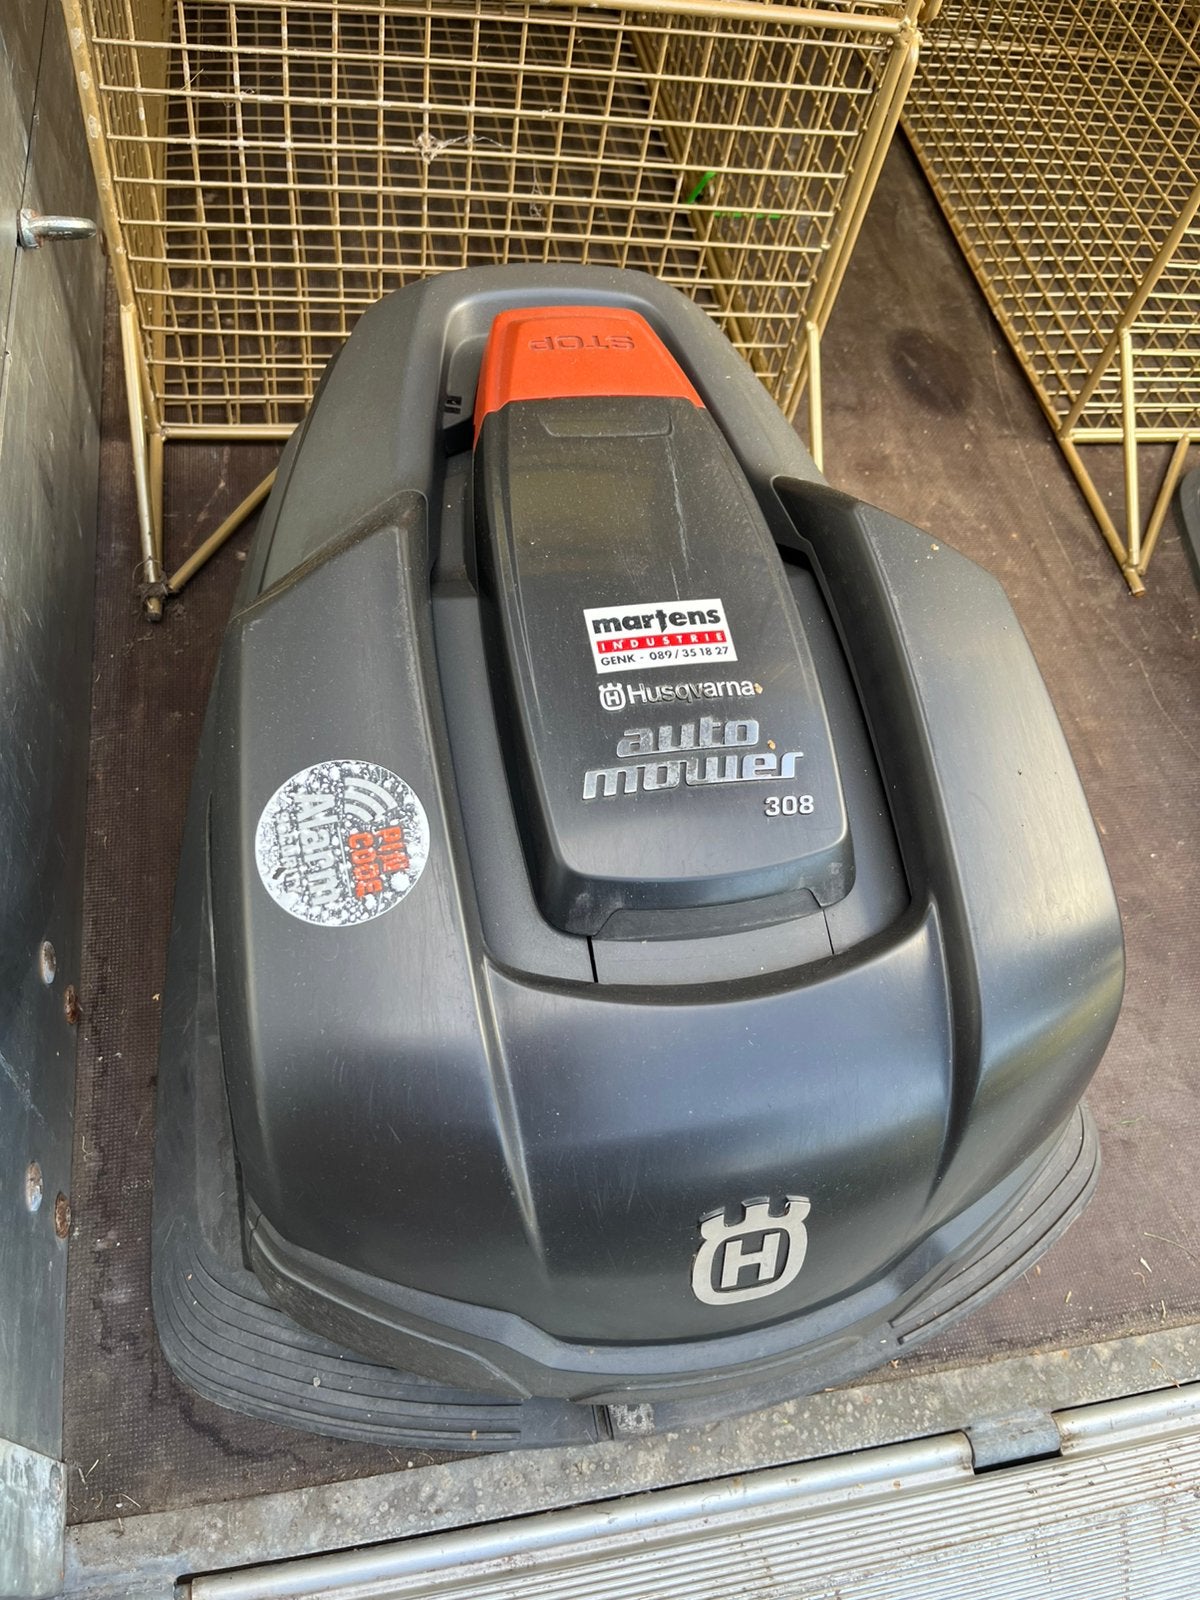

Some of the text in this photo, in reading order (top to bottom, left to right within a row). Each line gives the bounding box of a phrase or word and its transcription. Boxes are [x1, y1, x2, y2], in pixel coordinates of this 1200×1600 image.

[529, 334, 635, 352] STOP
[592, 609, 721, 634] martens
[601, 632, 723, 652] INDUSTRIE
[601, 654, 636, 666] GENK
[627, 680, 755, 704] Husqvarna
[616, 716, 760, 758] auto
[582, 751, 804, 800] mower
[764, 794, 815, 817] 308
[293, 793, 341, 907] Alarm
[376, 825, 410, 873] PIN
[348, 831, 384, 900] CODE
